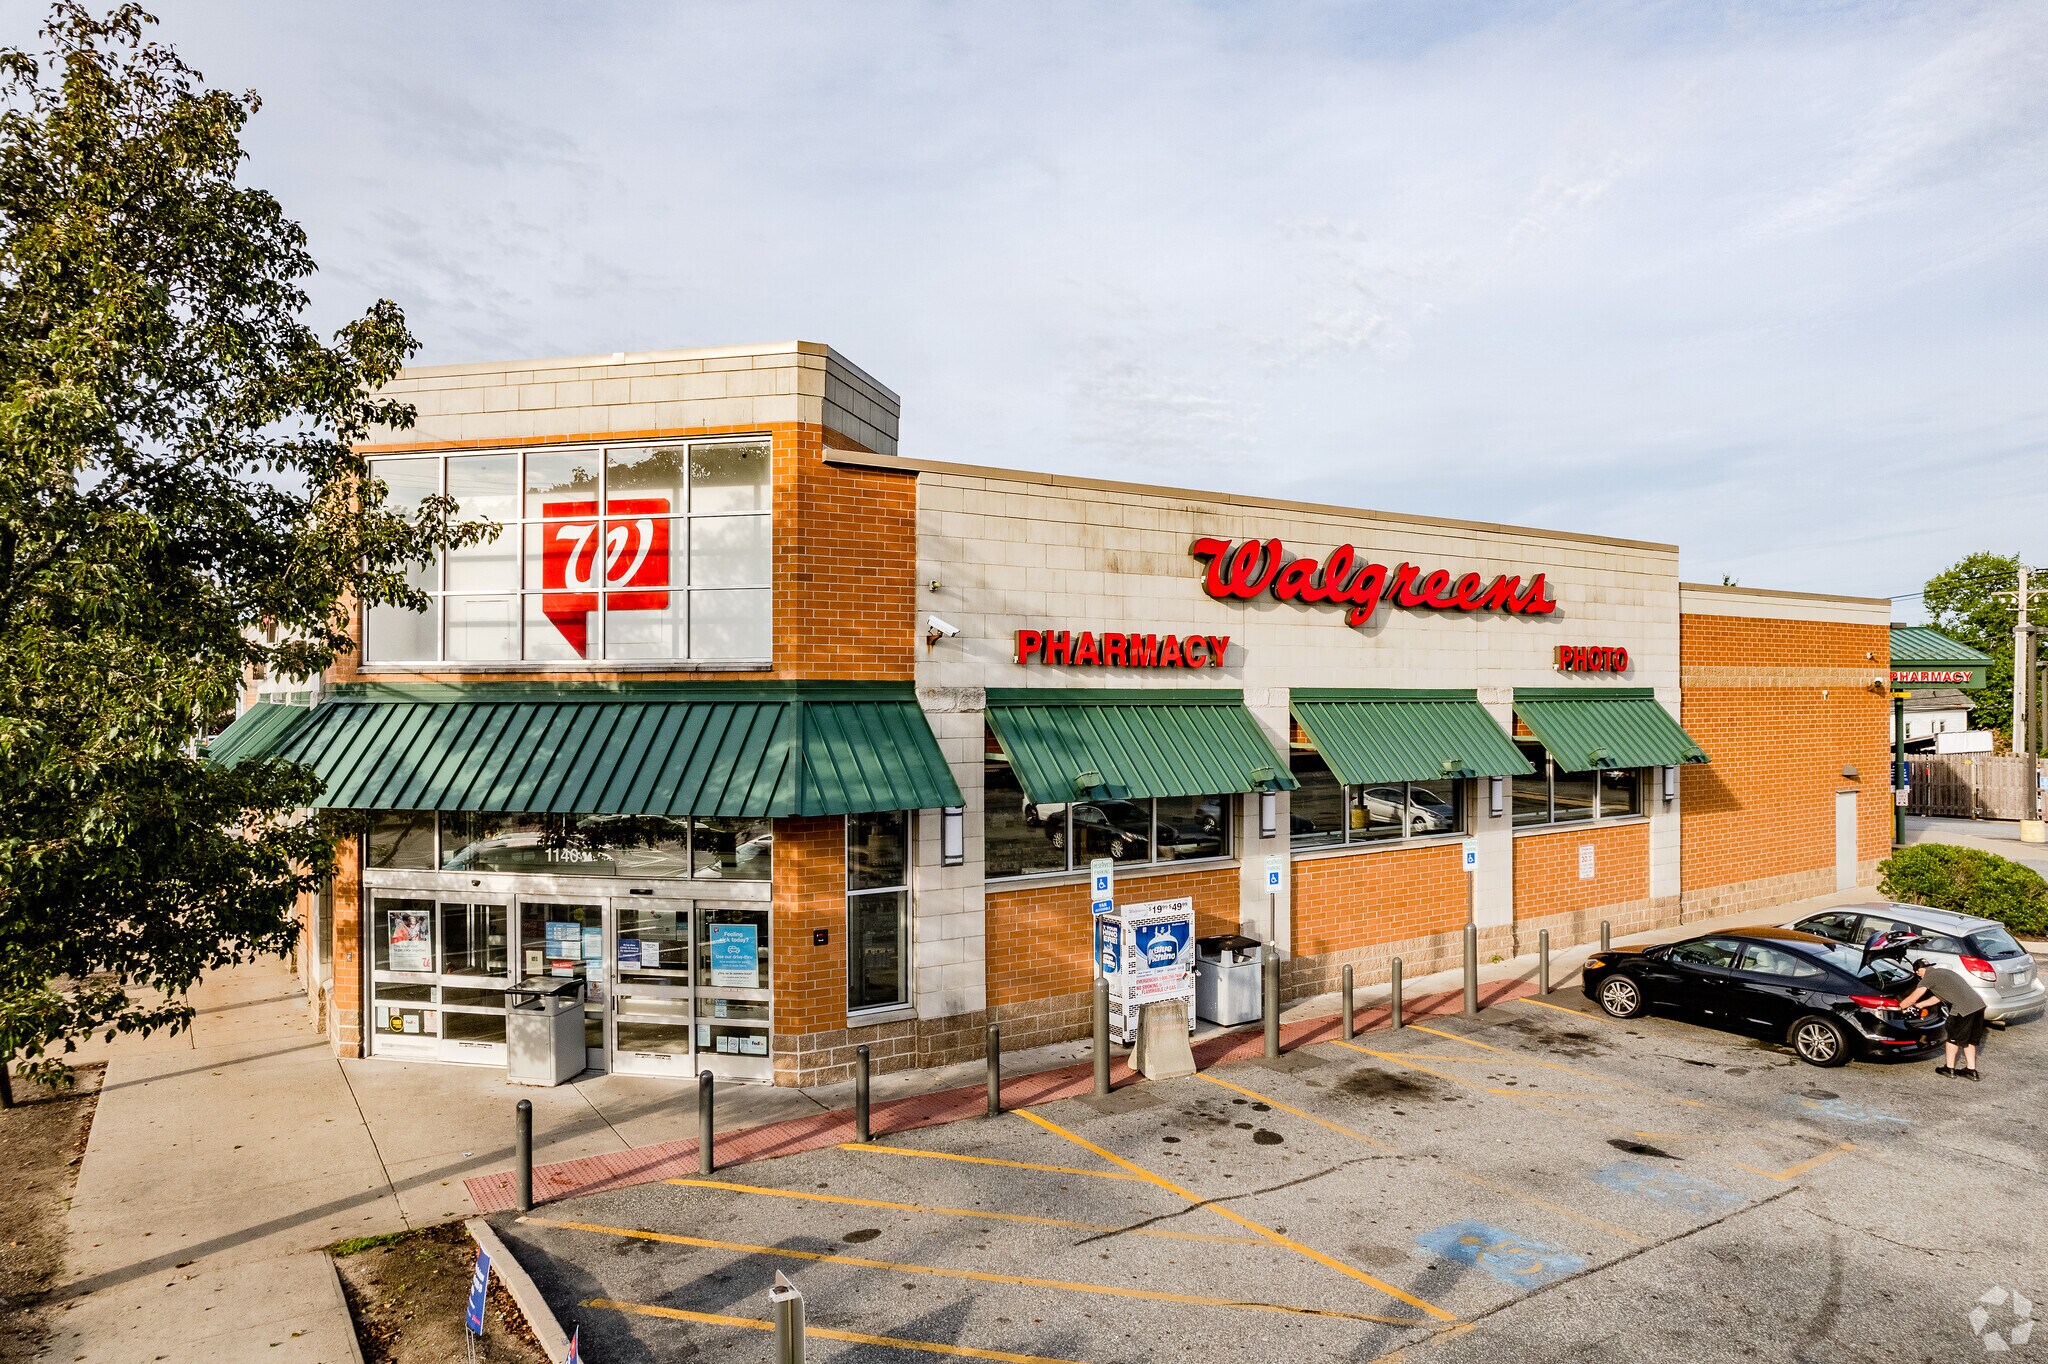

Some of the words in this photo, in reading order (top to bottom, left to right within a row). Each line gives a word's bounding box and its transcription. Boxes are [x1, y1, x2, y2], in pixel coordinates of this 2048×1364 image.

[1194, 536, 1557, 627] Walgreens
[1017, 629, 1231, 669] PHARMACY
[1558, 645, 1629, 674] PHOTO
[1889, 670, 1973, 683] PHARMACY
